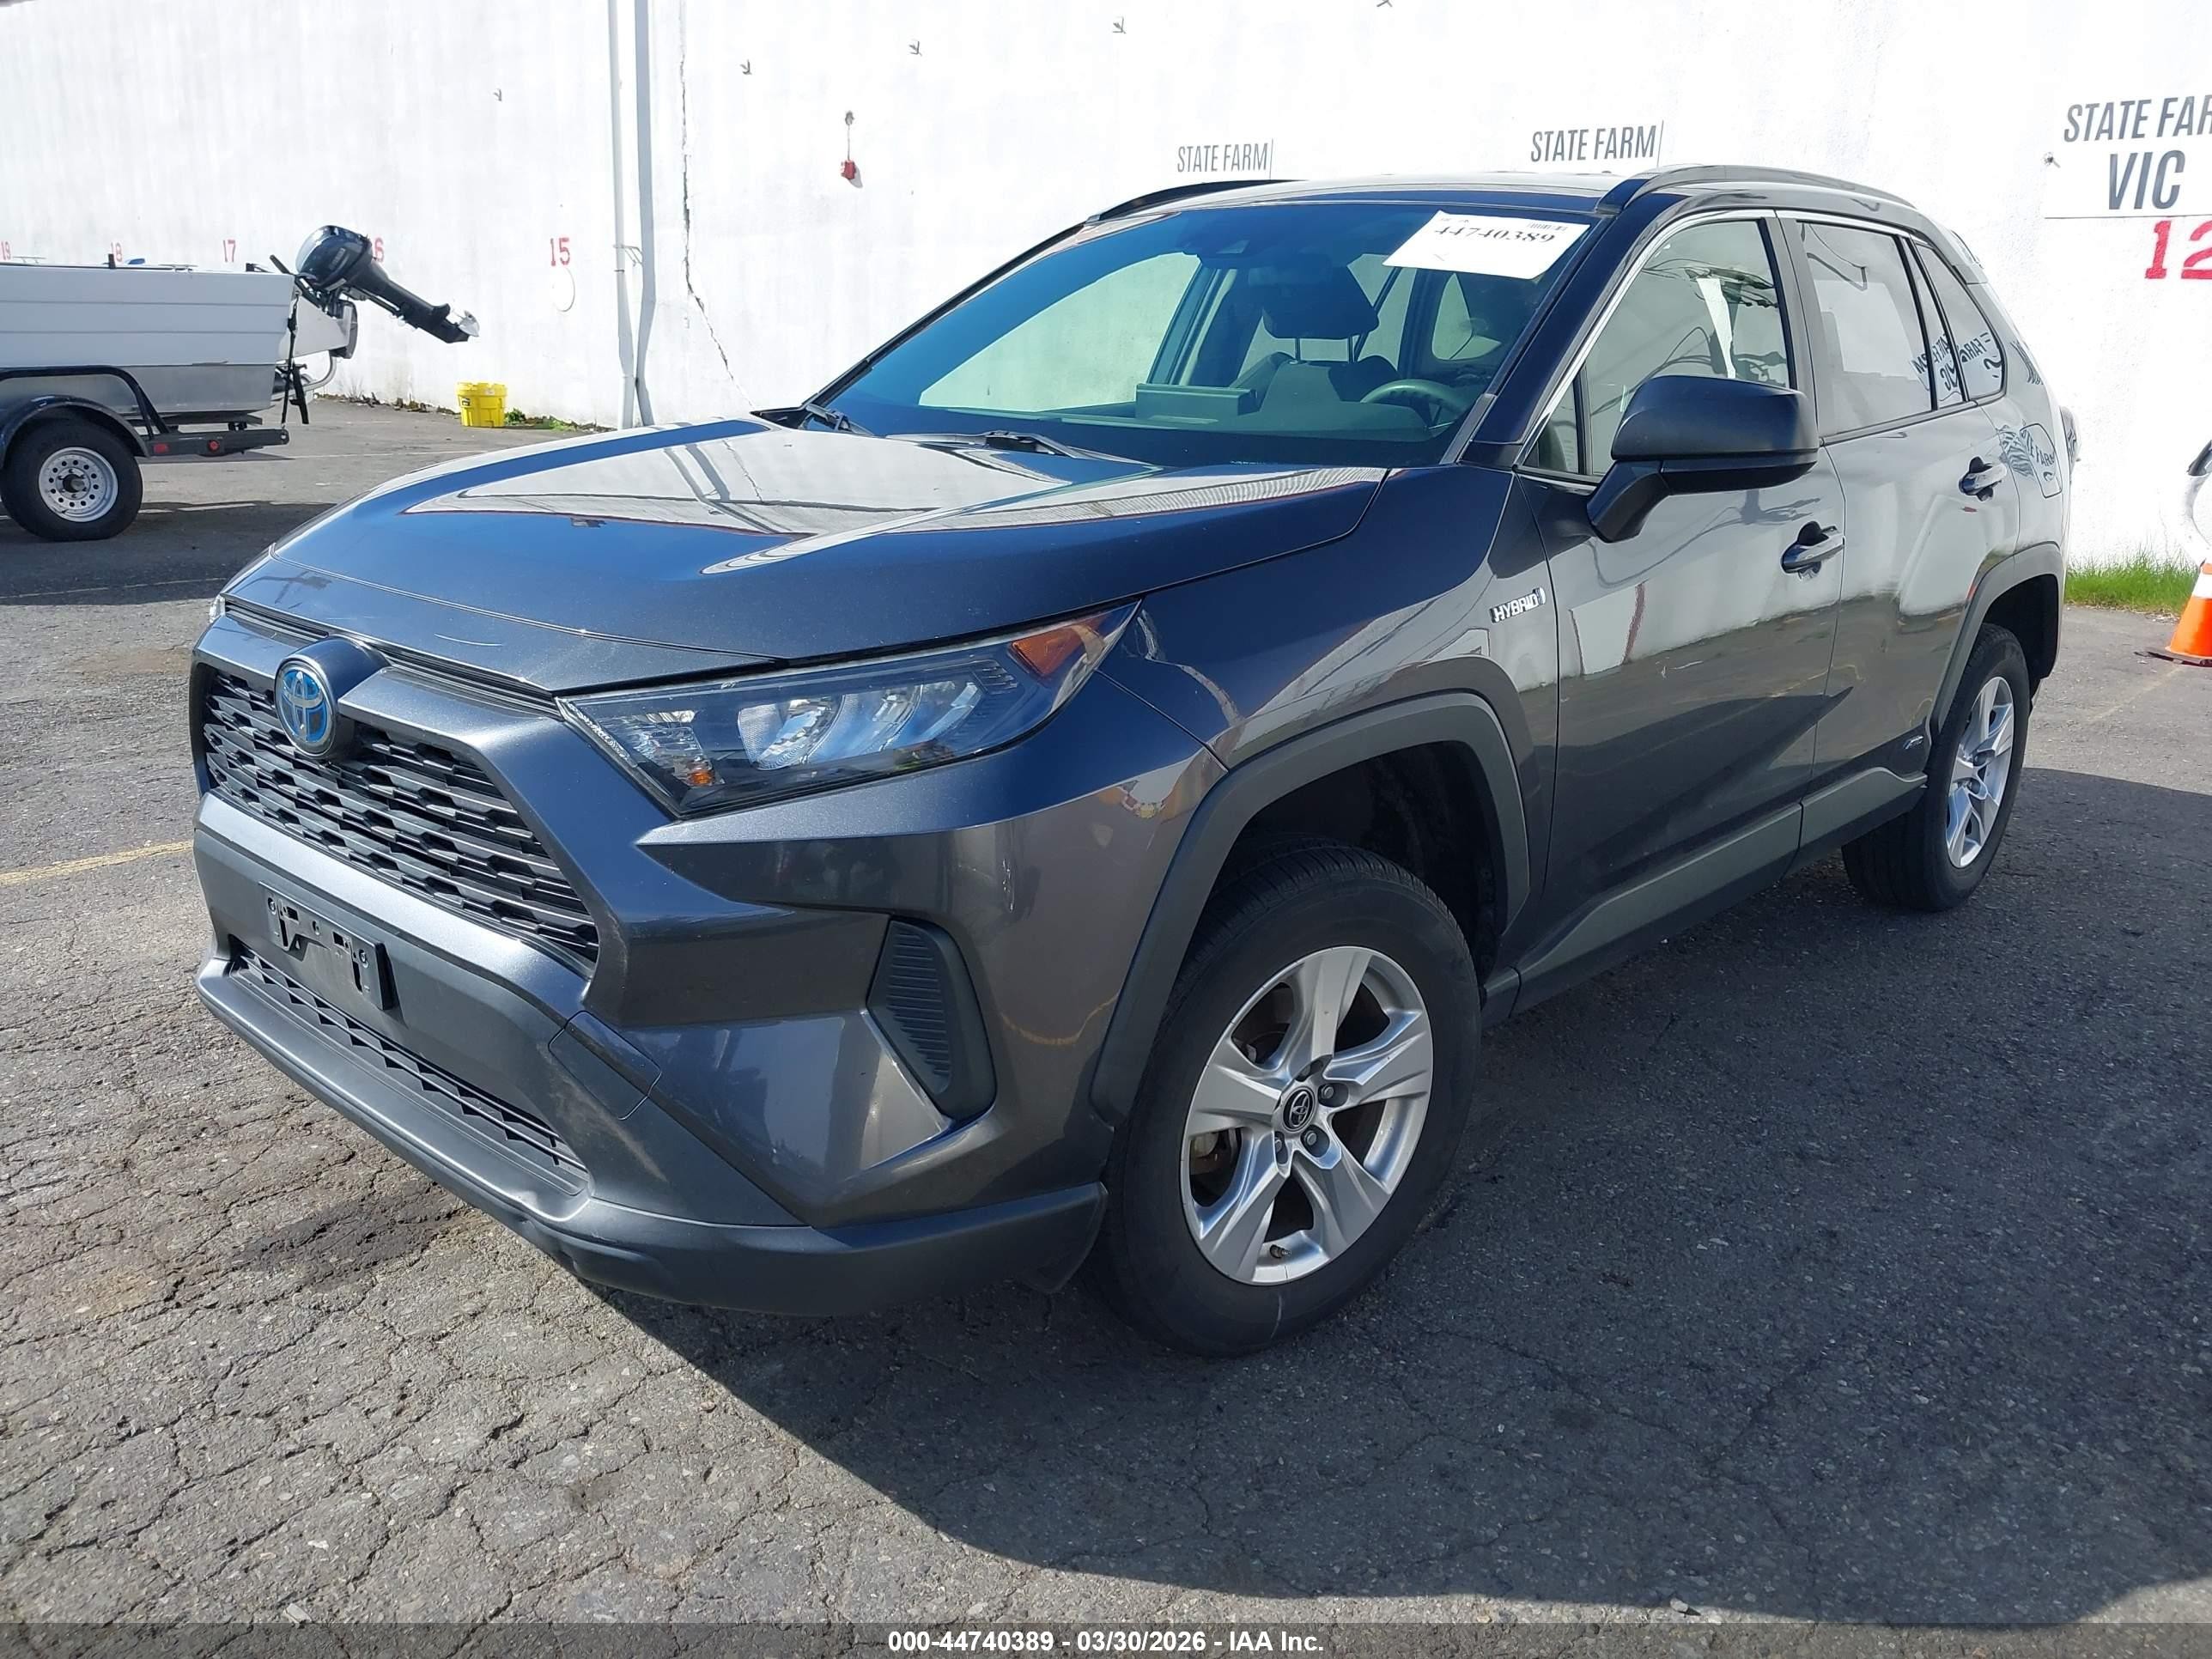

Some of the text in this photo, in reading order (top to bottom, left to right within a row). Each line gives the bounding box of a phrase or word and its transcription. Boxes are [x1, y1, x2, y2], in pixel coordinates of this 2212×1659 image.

[2064, 99, 2152, 143] STATE
[1177, 143, 1268, 173] STATE FARM
[1531, 125, 1656, 162] STATE FARM
[2108, 149, 2186, 210] VIC
[223, 240, 236, 263] 17
[374, 237, 385, 263] 6
[550, 237, 570, 266] 15
[2144, 220, 2212, 280] 12
[1492, 592, 1540, 623] HYBRID
